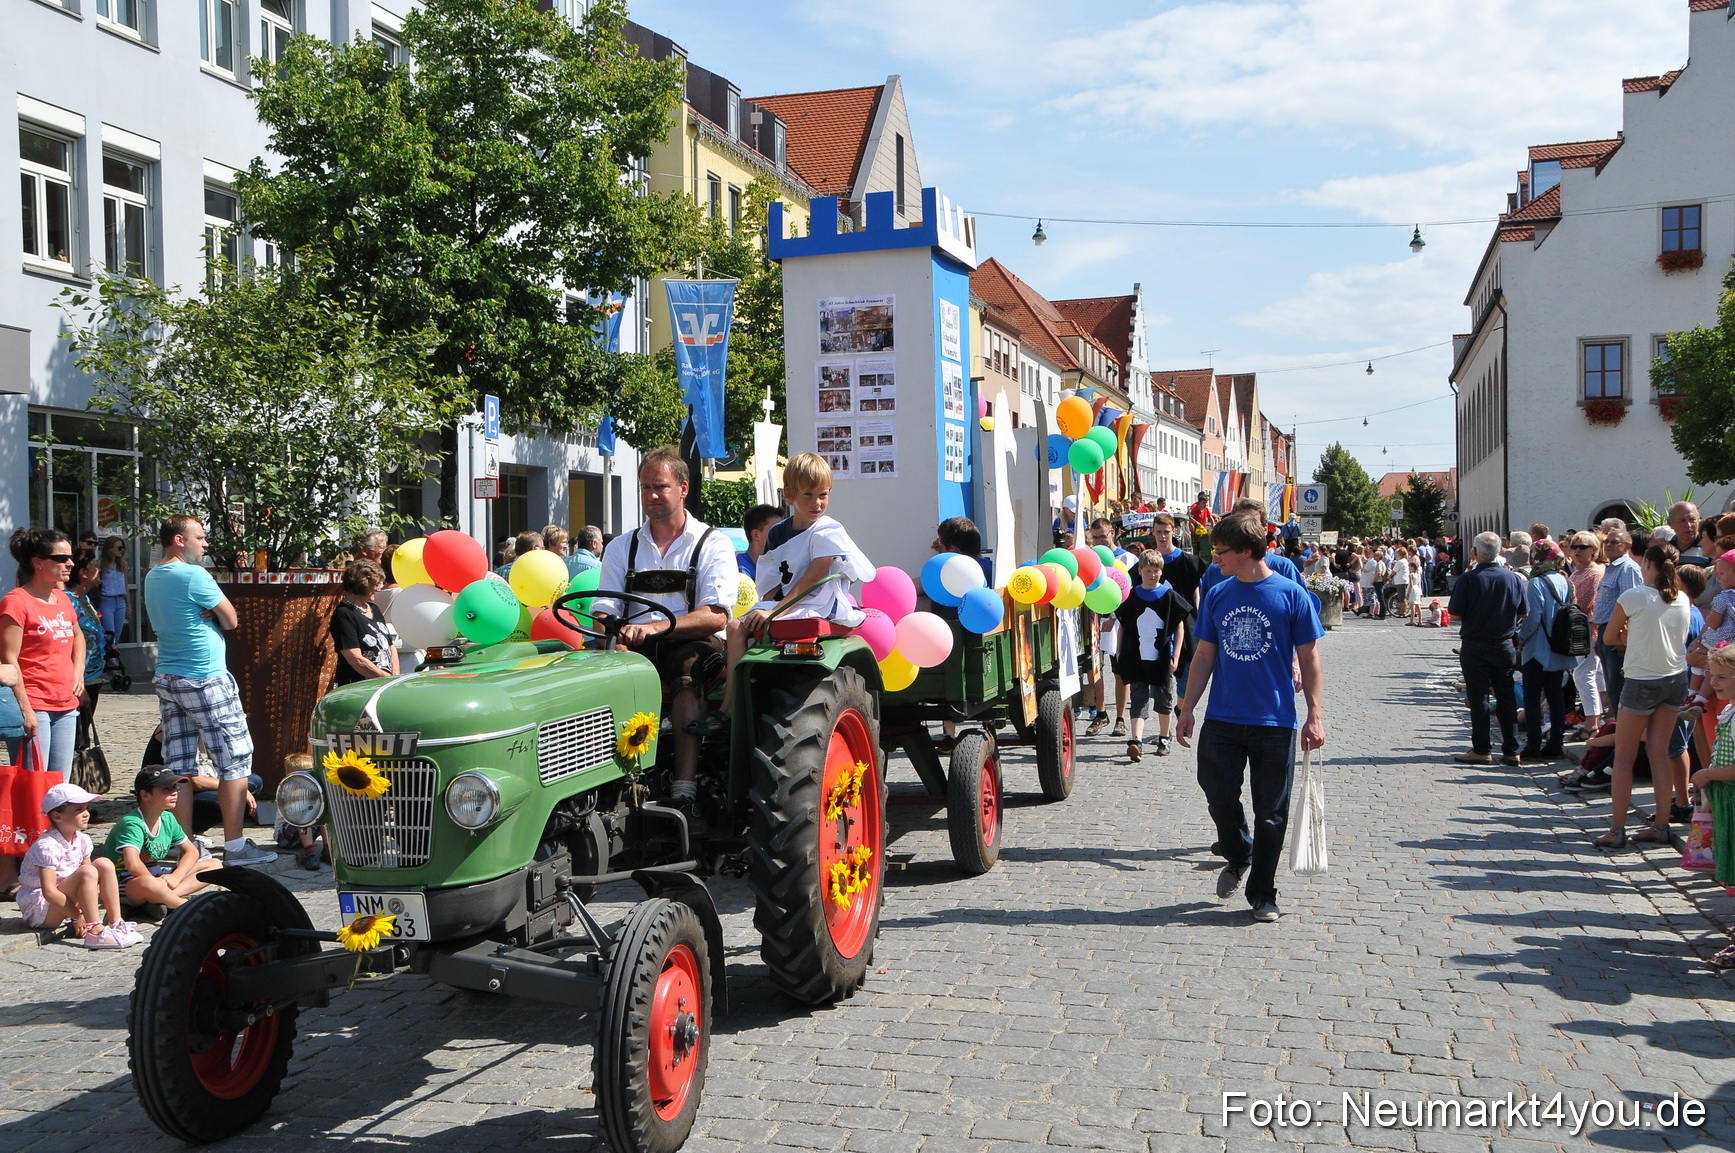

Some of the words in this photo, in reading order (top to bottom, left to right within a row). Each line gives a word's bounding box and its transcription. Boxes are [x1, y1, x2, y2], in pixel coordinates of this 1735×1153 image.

[488, 401, 496, 434] P
[1221, 605, 1271, 628] SCHACHKLUB
[326, 733, 418, 755] FENDT
[356, 895, 385, 916] NM
